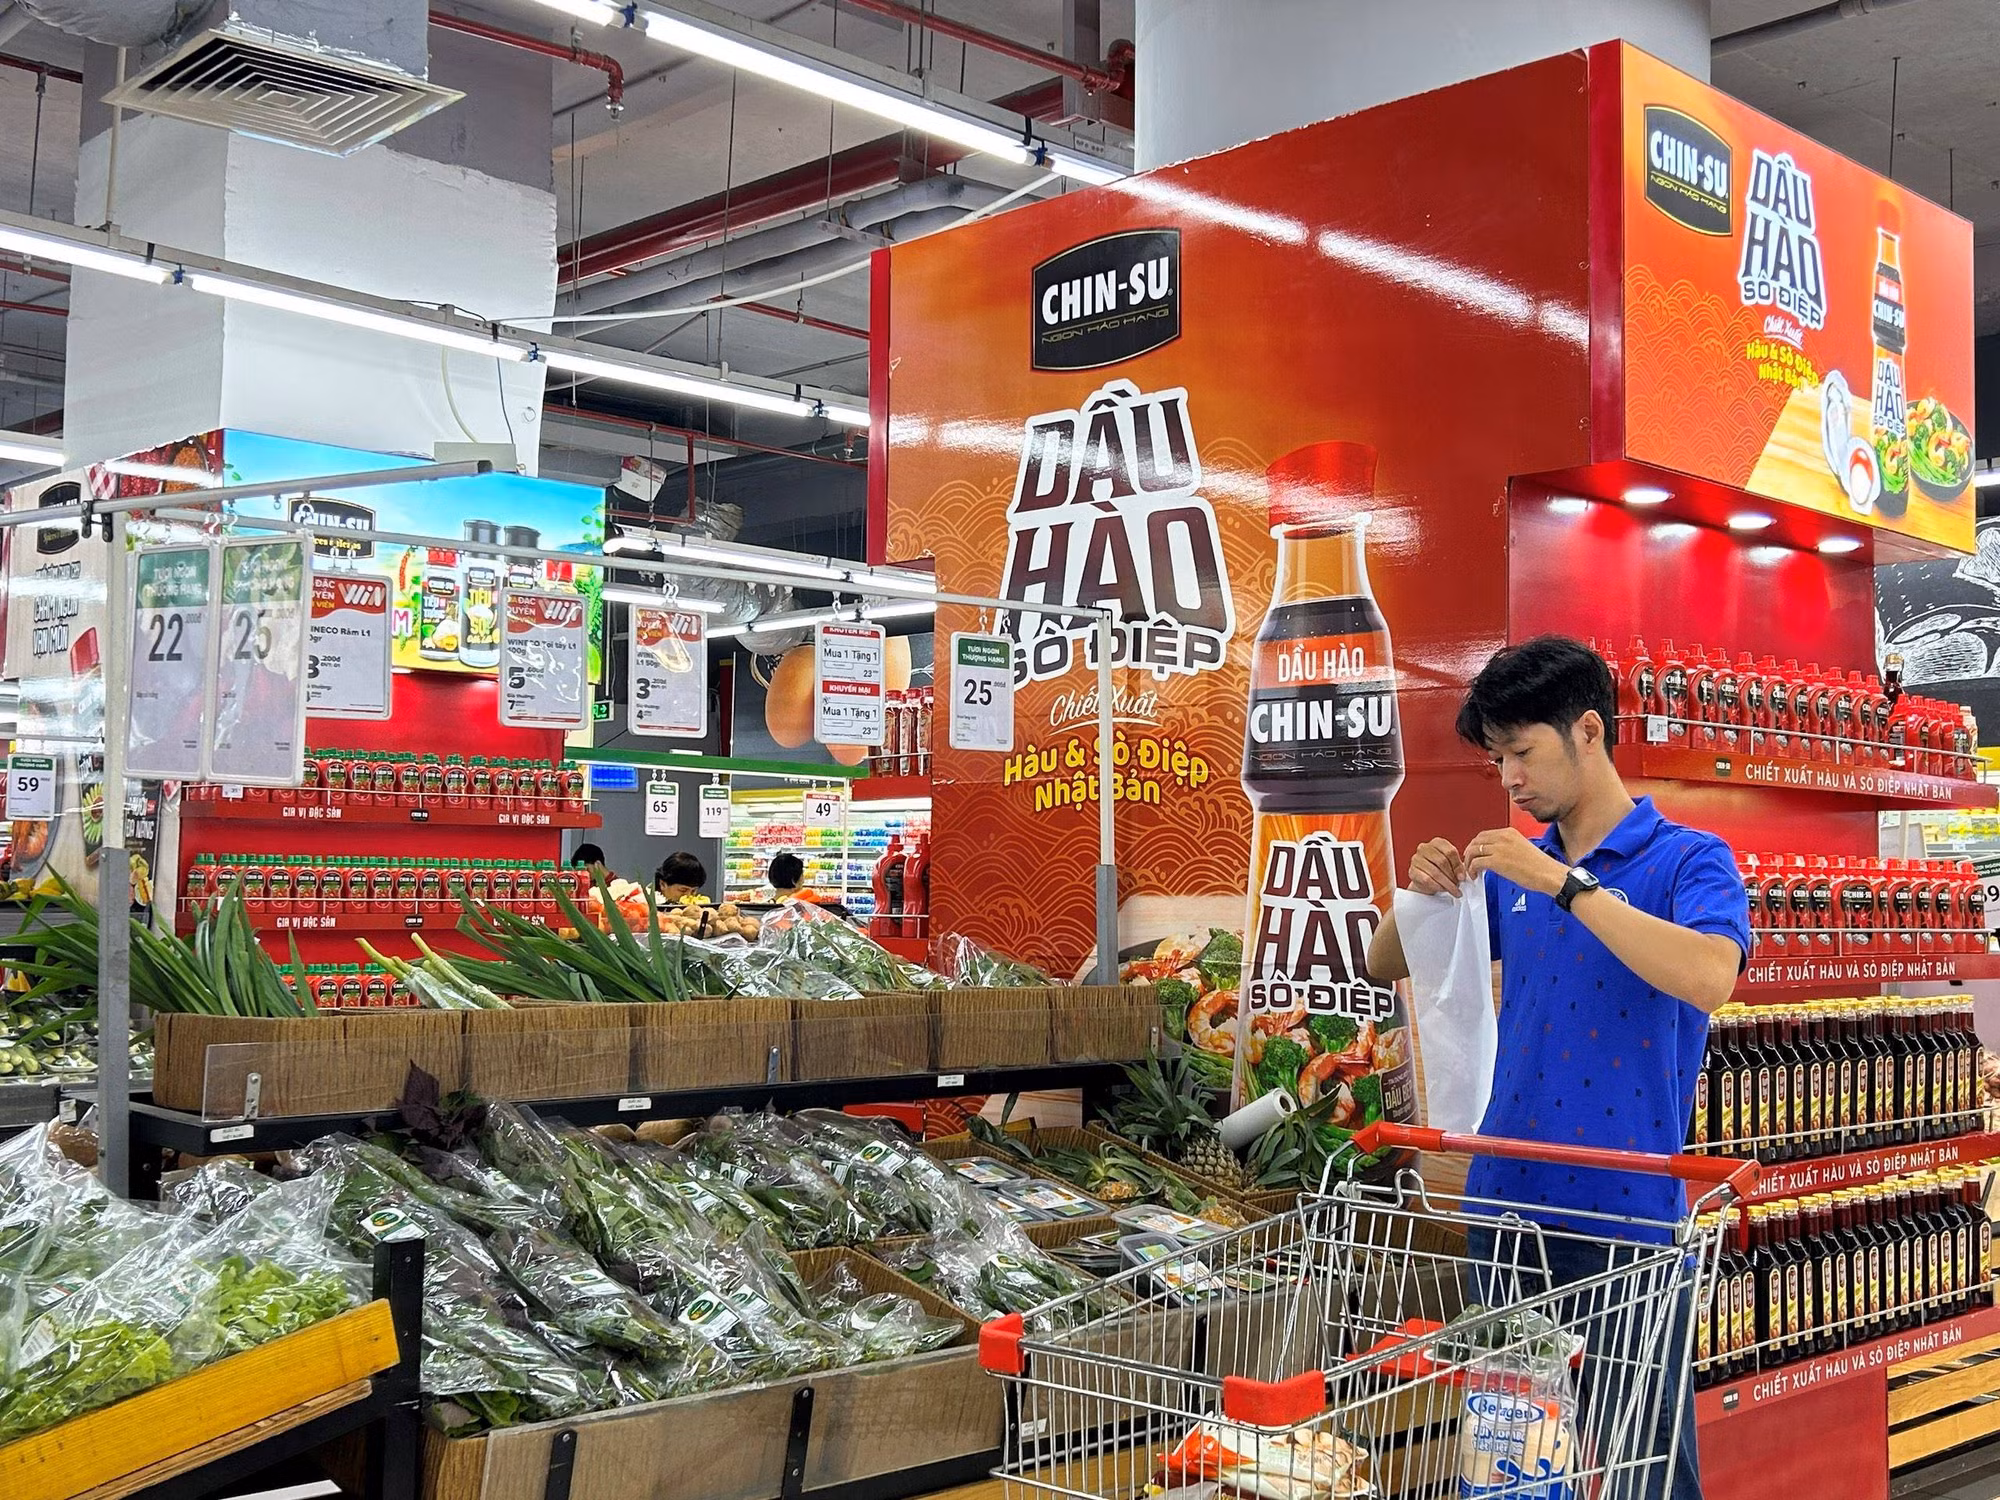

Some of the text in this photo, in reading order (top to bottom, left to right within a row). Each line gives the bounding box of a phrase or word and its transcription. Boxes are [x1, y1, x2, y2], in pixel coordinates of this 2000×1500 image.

[1650, 130, 1728, 199] CHIN-SU
[1750, 155, 1812, 229] DẦU
[1741, 211, 1824, 311] HÀO
[1042, 256, 1170, 325] CHIN-SU
[1778, 286, 1821, 326] ĐIỆP
[1042, 329, 1083, 344] NGON
[1014, 388, 1194, 514] DẦU
[999, 500, 1226, 644] HÀO
[149, 613, 184, 662] 22
[234, 608, 272, 660] 25
[311, 625, 339, 635] INECO
[1089, 616, 1222, 675] ĐIỆP
[823, 648, 842, 658] Mua
[844, 650, 849, 658] 1
[873, 652, 877, 660] 1
[863, 669, 872, 678] 23
[1278, 642, 1365, 683] DẦU HÀO
[508, 666, 526, 689] 5
[636, 677, 650, 700] 3
[964, 678, 992, 706] 25
[823, 706, 841, 716] Mua
[843, 707, 848, 716] 1
[873, 709, 877, 718] 1
[1050, 684, 1160, 727] Chiết Xuất
[1250, 695, 1392, 743] CHIN-SU
[862, 727, 871, 735] 23
[1004, 737, 1209, 788] Hàu & Điệp
[1745, 760, 1952, 801] CHIẾT XUẤT HÀU VÀ SÒ ĐIỆP NHẬT BẢN
[17, 776, 39, 792] 59
[1035, 769, 1161, 812] Nhật Bản
[282, 806, 296, 817] GIA
[308, 806, 324, 819] ĐẶC
[326, 805, 342, 818] SẢN
[653, 800, 668, 813] 65
[706, 807, 722, 816] 119
[815, 802, 831, 817] 49
[1263, 836, 1371, 900] DẦU
[276, 916, 289, 928] GIA
[302, 916, 318, 929] ĐẶC
[320, 915, 336, 928] SẢN
[1251, 900, 1393, 992] HÀO
[1748, 956, 1956, 983] CHIẾT XUẤT HÀU VÀ SÒ ĐIỆP NHẬT BẢN
[1251, 974, 1393, 1023] SÒ ĐIỆP
[1790, 1163, 1819, 1188] XUẤT
[1822, 1162, 1845, 1183] HÀU
[1849, 1157, 1863, 1179] VÀ
[1866, 1155, 1880, 1176] SÒ
[1884, 1151, 1907, 1174] ĐIỆP
[1910, 1147, 1936, 1170] NHẬT
[1938, 1141, 1959, 1162] BẢN
[1753, 1372, 1788, 1402] CHIẾT
[1792, 1360, 1821, 1390] XUẤT
[1852, 1349, 1866, 1371] VÀ
[1869, 1347, 1883, 1365] SÒ
[1913, 1329, 1939, 1354] NHẬT
[1942, 1323, 1962, 1344] BẢN
